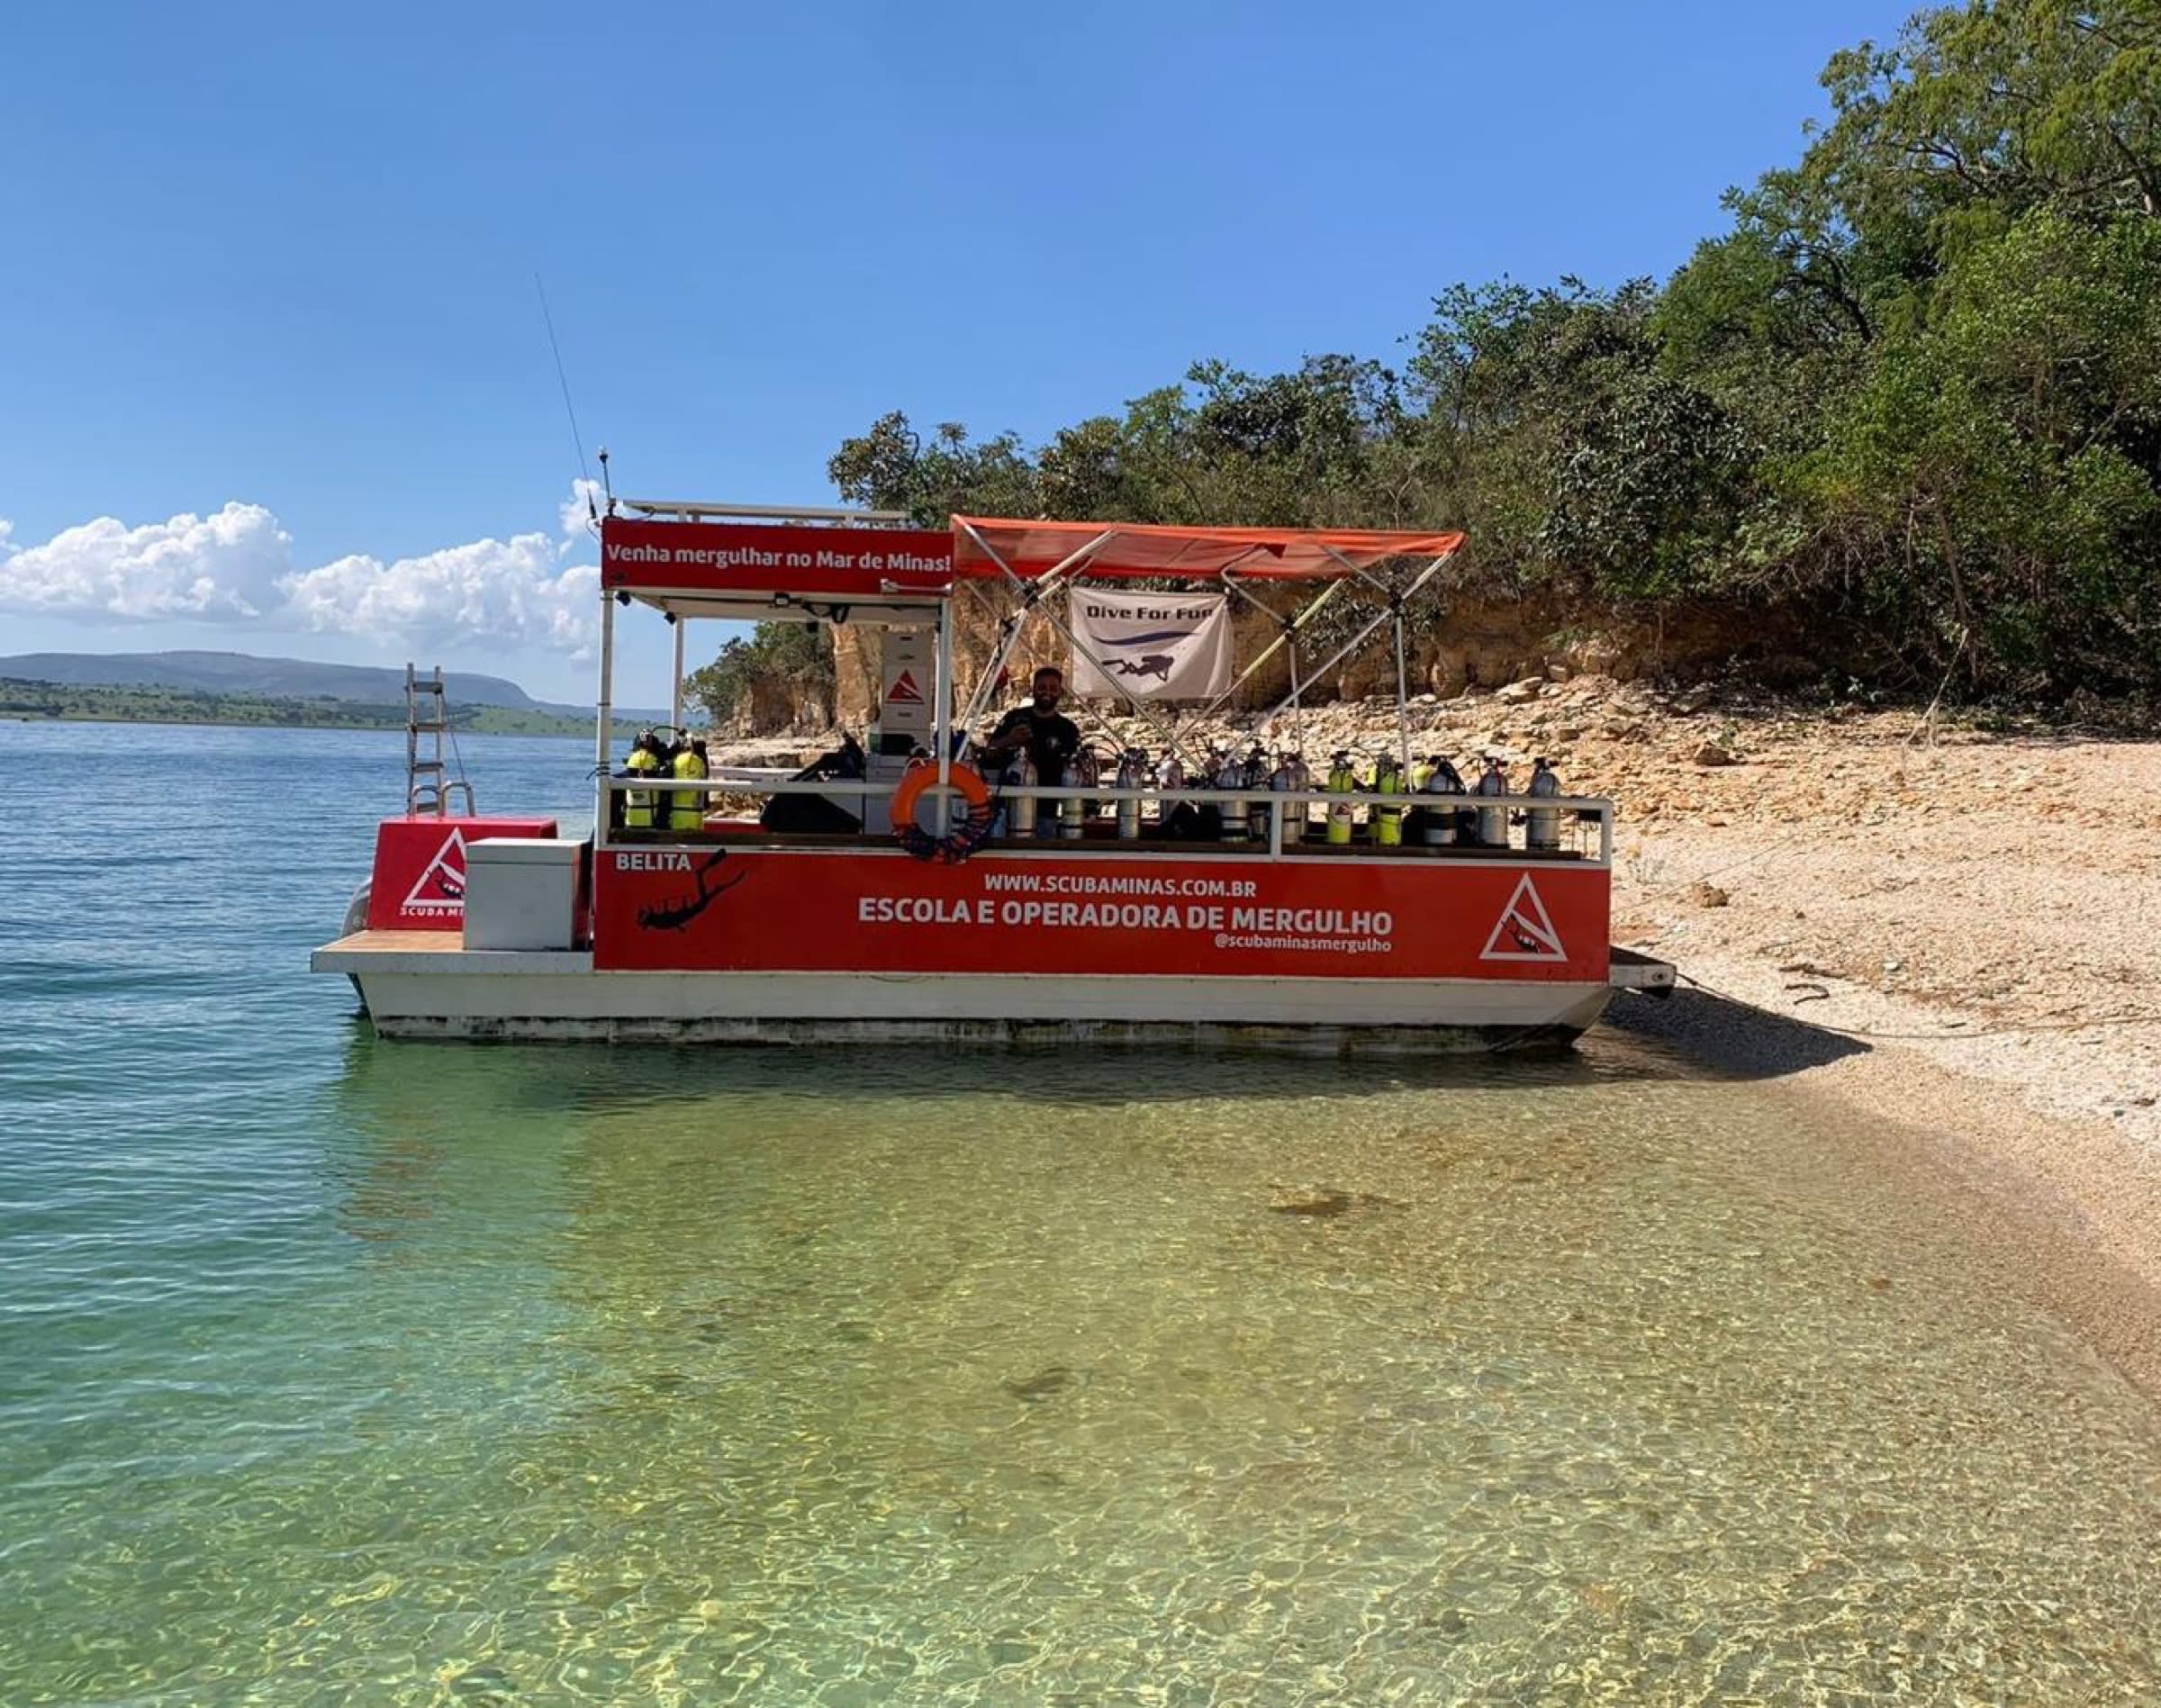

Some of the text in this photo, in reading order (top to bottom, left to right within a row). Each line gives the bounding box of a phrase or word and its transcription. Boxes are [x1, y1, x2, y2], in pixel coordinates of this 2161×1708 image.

[606, 544, 952, 572] Venha mergulhar no Mar de Minas!
[1086, 605, 1132, 619] Dive
[1137, 607, 1171, 620] For
[616, 853, 692, 871] BELITA
[984, 873, 1257, 898] WWW.SCUBAMINAS.COM.BR
[399, 906, 445, 917] SCUBA
[858, 897, 1393, 935] ESCOLA E OPERADORA DE MERGULHO
[1215, 932, 1392, 954] @scubaminasmergulho
